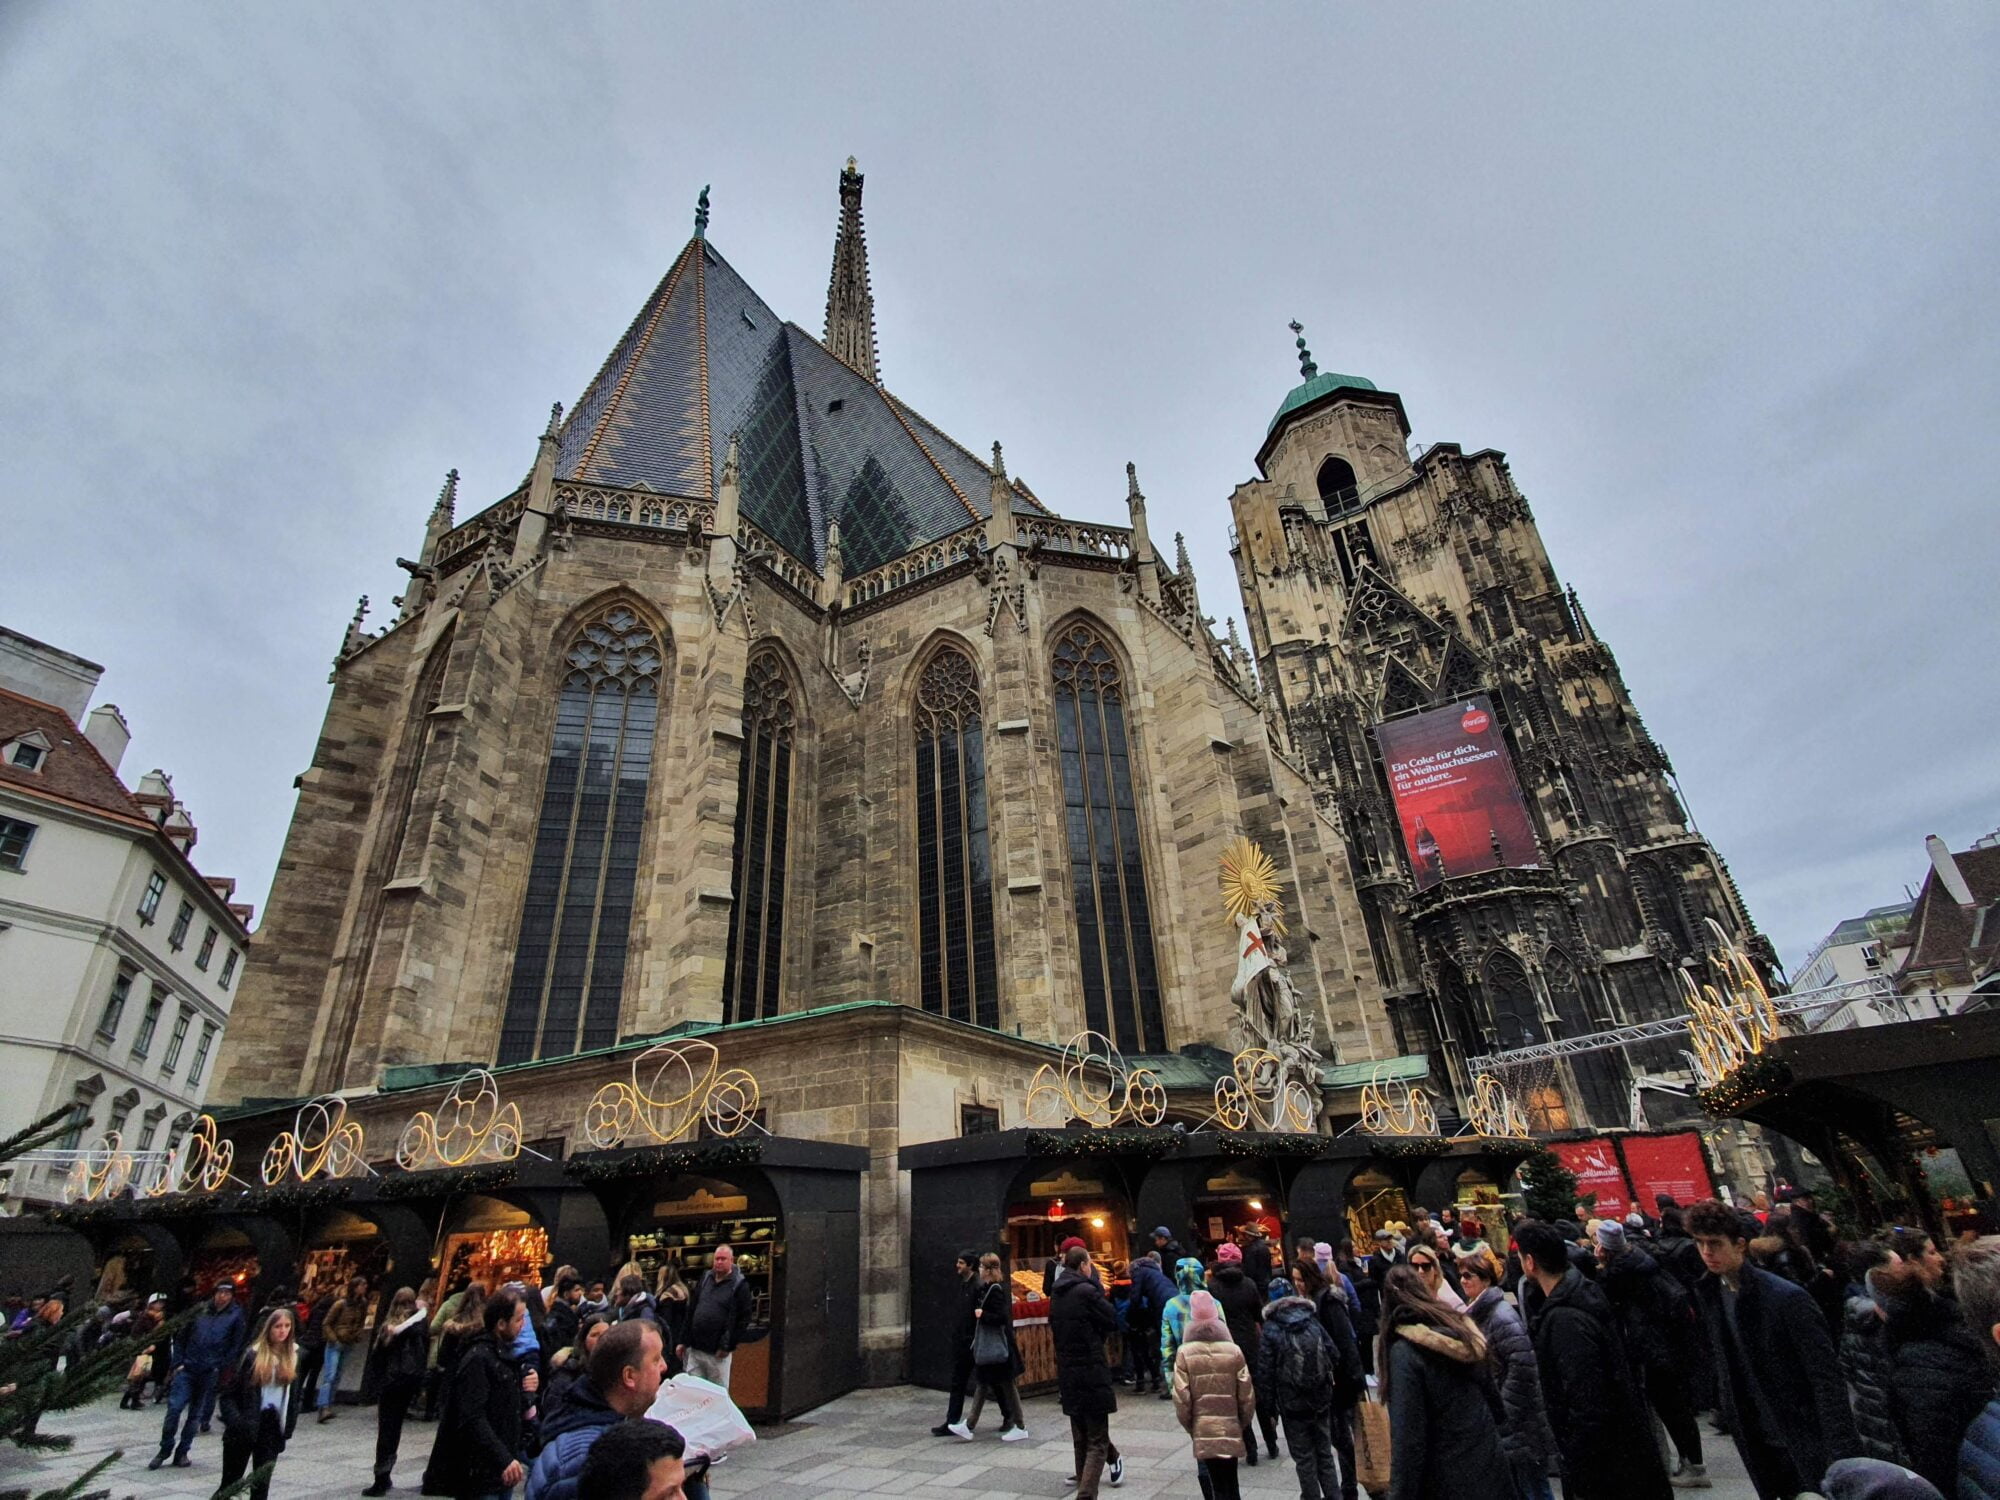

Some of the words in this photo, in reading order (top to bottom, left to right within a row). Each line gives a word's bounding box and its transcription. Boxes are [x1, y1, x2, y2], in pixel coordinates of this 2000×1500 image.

[1392, 763, 1408, 772] Ein
[1409, 755, 1435, 767] Coke
[1436, 750, 1452, 760] für
[1454, 744, 1479, 756] dich,
[1395, 772, 1409, 781] ein
[1410, 750, 1498, 776] Weihnachtsessen
[1397, 781, 1412, 790] für
[1414, 772, 1452, 785] andere.
